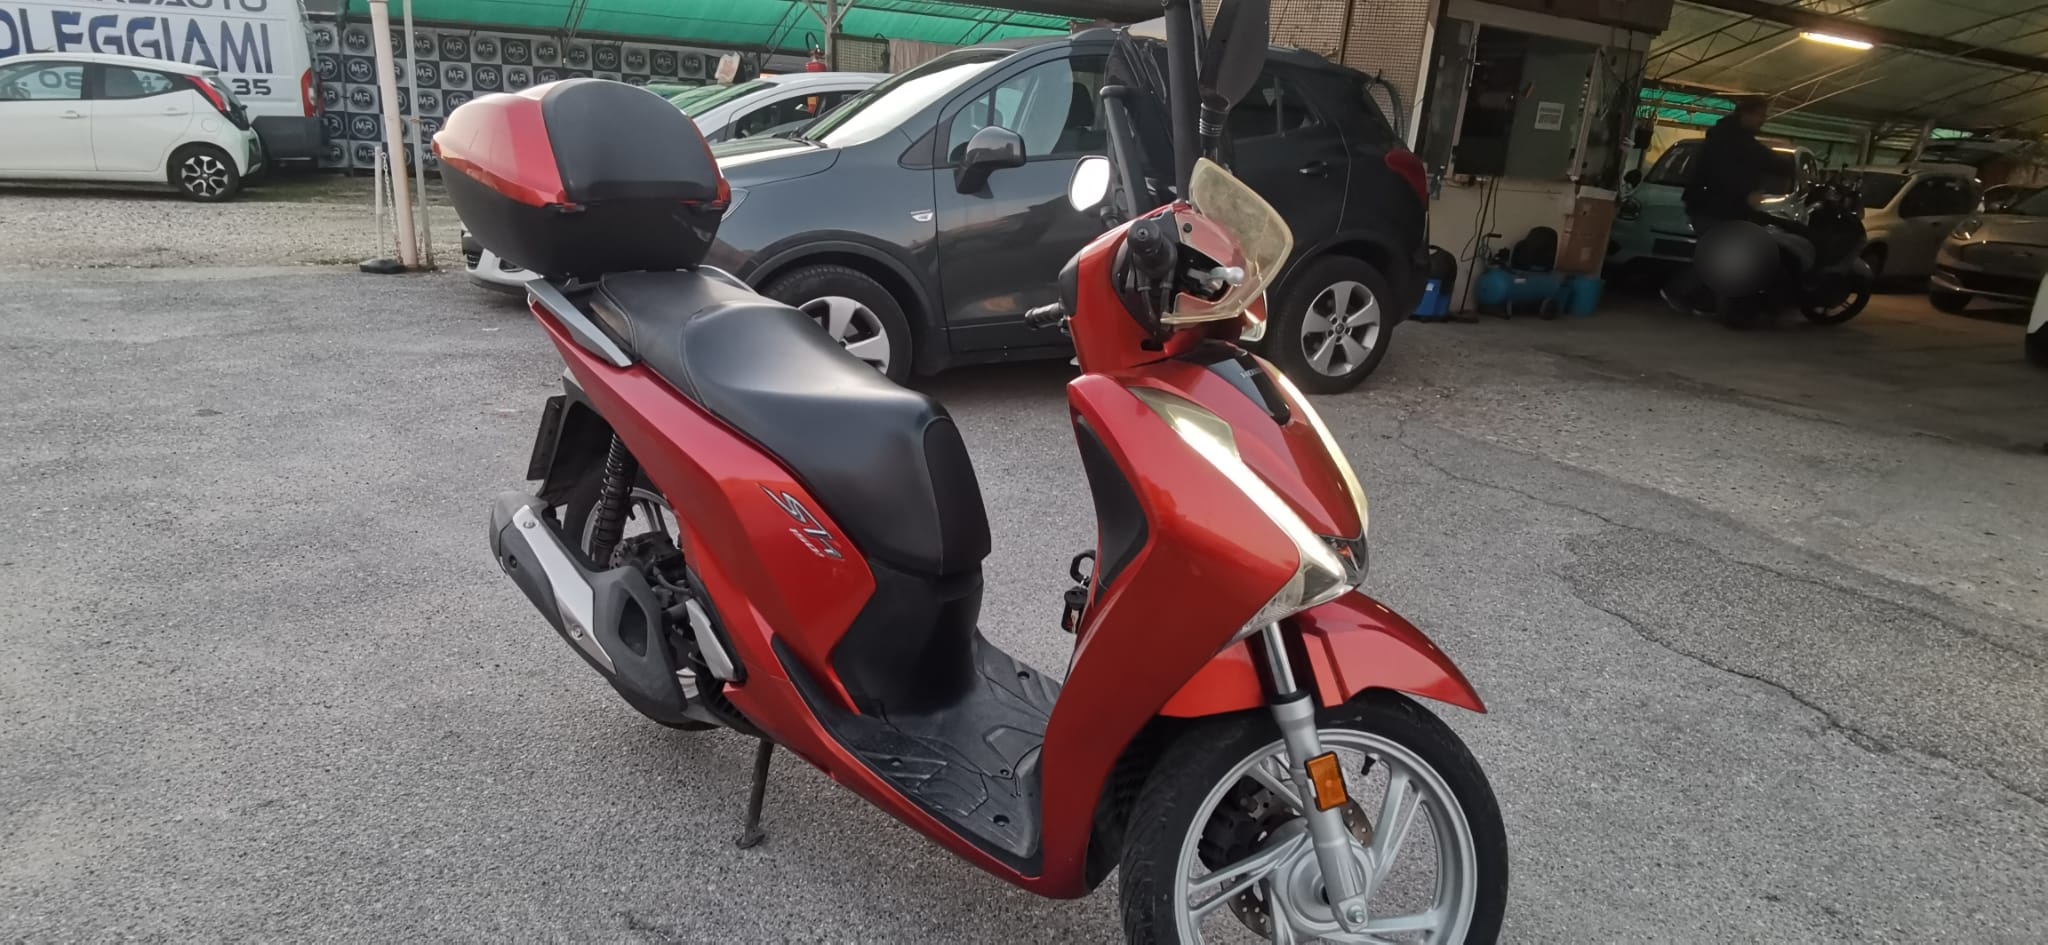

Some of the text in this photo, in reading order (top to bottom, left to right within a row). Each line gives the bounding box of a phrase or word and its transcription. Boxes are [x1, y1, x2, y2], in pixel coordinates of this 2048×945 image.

[348, 34, 366, 47] MR
[446, 41, 463, 51] MR
[477, 43, 494, 54] MR
[507, 45, 525, 55] MR
[538, 47, 555, 56] MR
[599, 51, 615, 61] MR
[627, 54, 643, 64] MR
[656, 56, 672, 66] MR
[350, 63, 369, 75] MR
[416, 69, 433, 79] MR
[448, 70, 465, 80] MR
[479, 72, 496, 82] MR
[510, 74, 527, 83] MR
[232, 78, 272, 96] 35
[353, 92, 371, 103] MR
[418, 97, 436, 107] MR
[355, 120, 374, 131] MR
